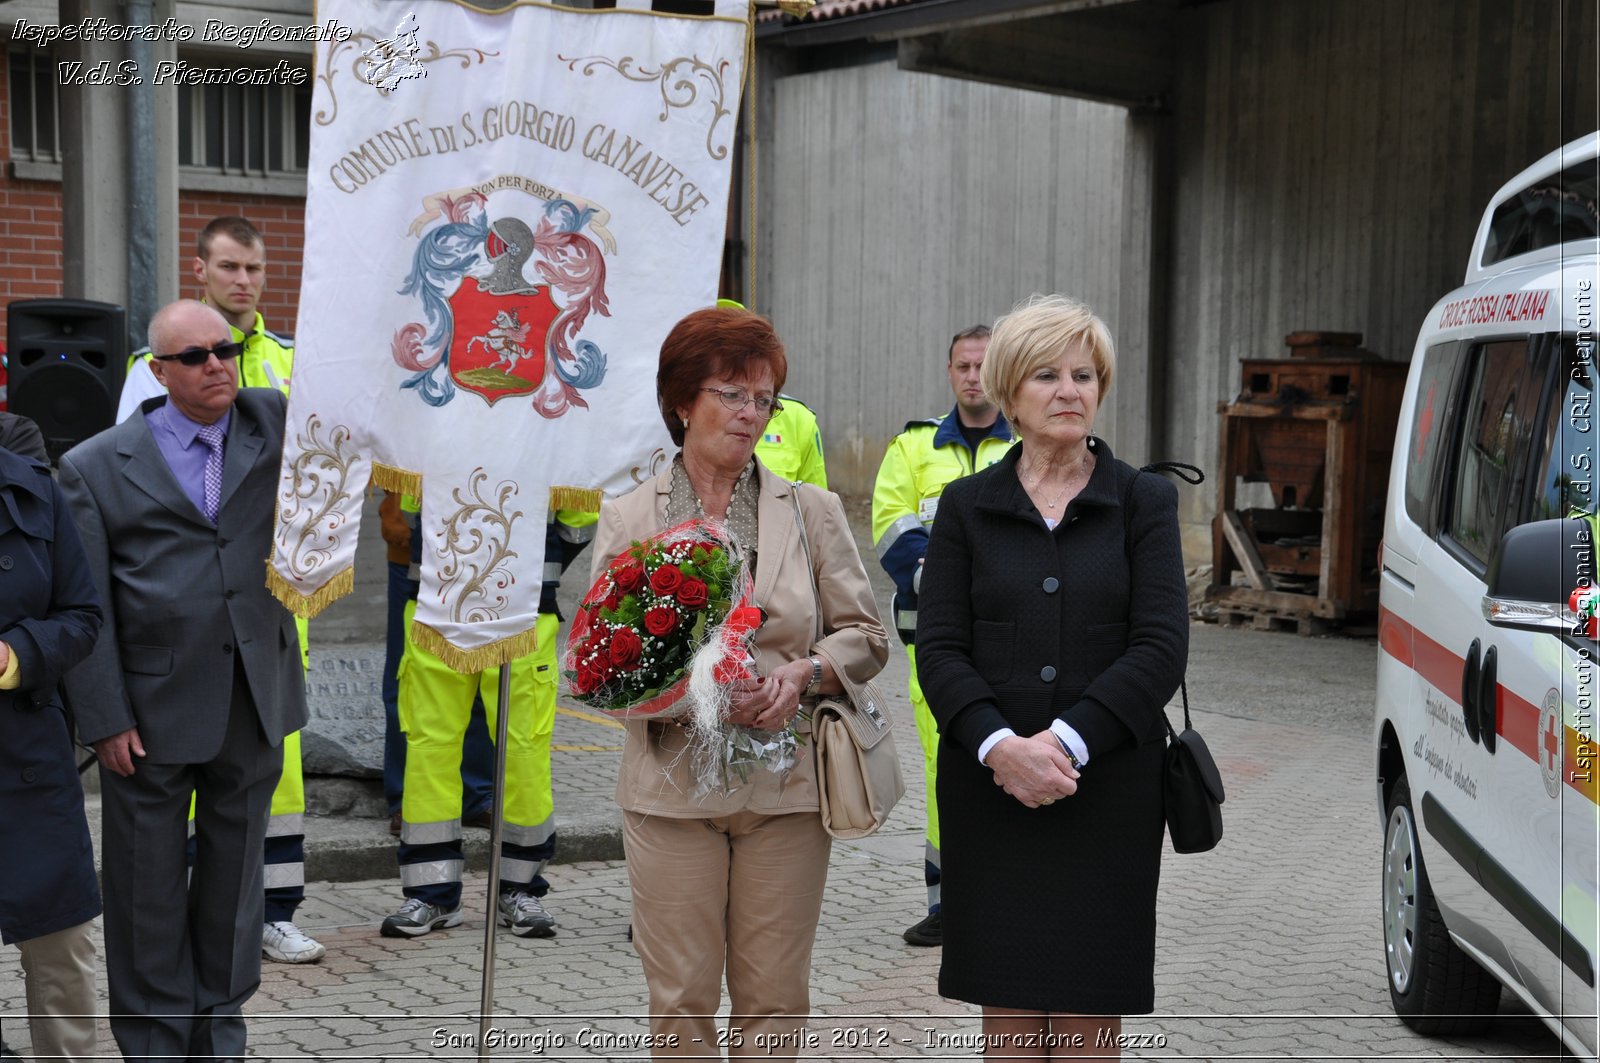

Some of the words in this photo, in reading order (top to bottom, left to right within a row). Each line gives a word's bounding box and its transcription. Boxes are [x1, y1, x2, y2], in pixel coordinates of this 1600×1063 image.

[329, 117, 432, 195] COMUNE
[429, 125, 459, 155] DI
[581, 122, 710, 227] CANAVESE
[471, 178, 496, 195] NON
[498, 176, 522, 189] PER
[524, 179, 563, 201] FORZA
[1439, 299, 1470, 330] CROCE
[1466, 295, 1499, 324] ROSSA
[1495, 290, 1550, 323] ITALIANA
